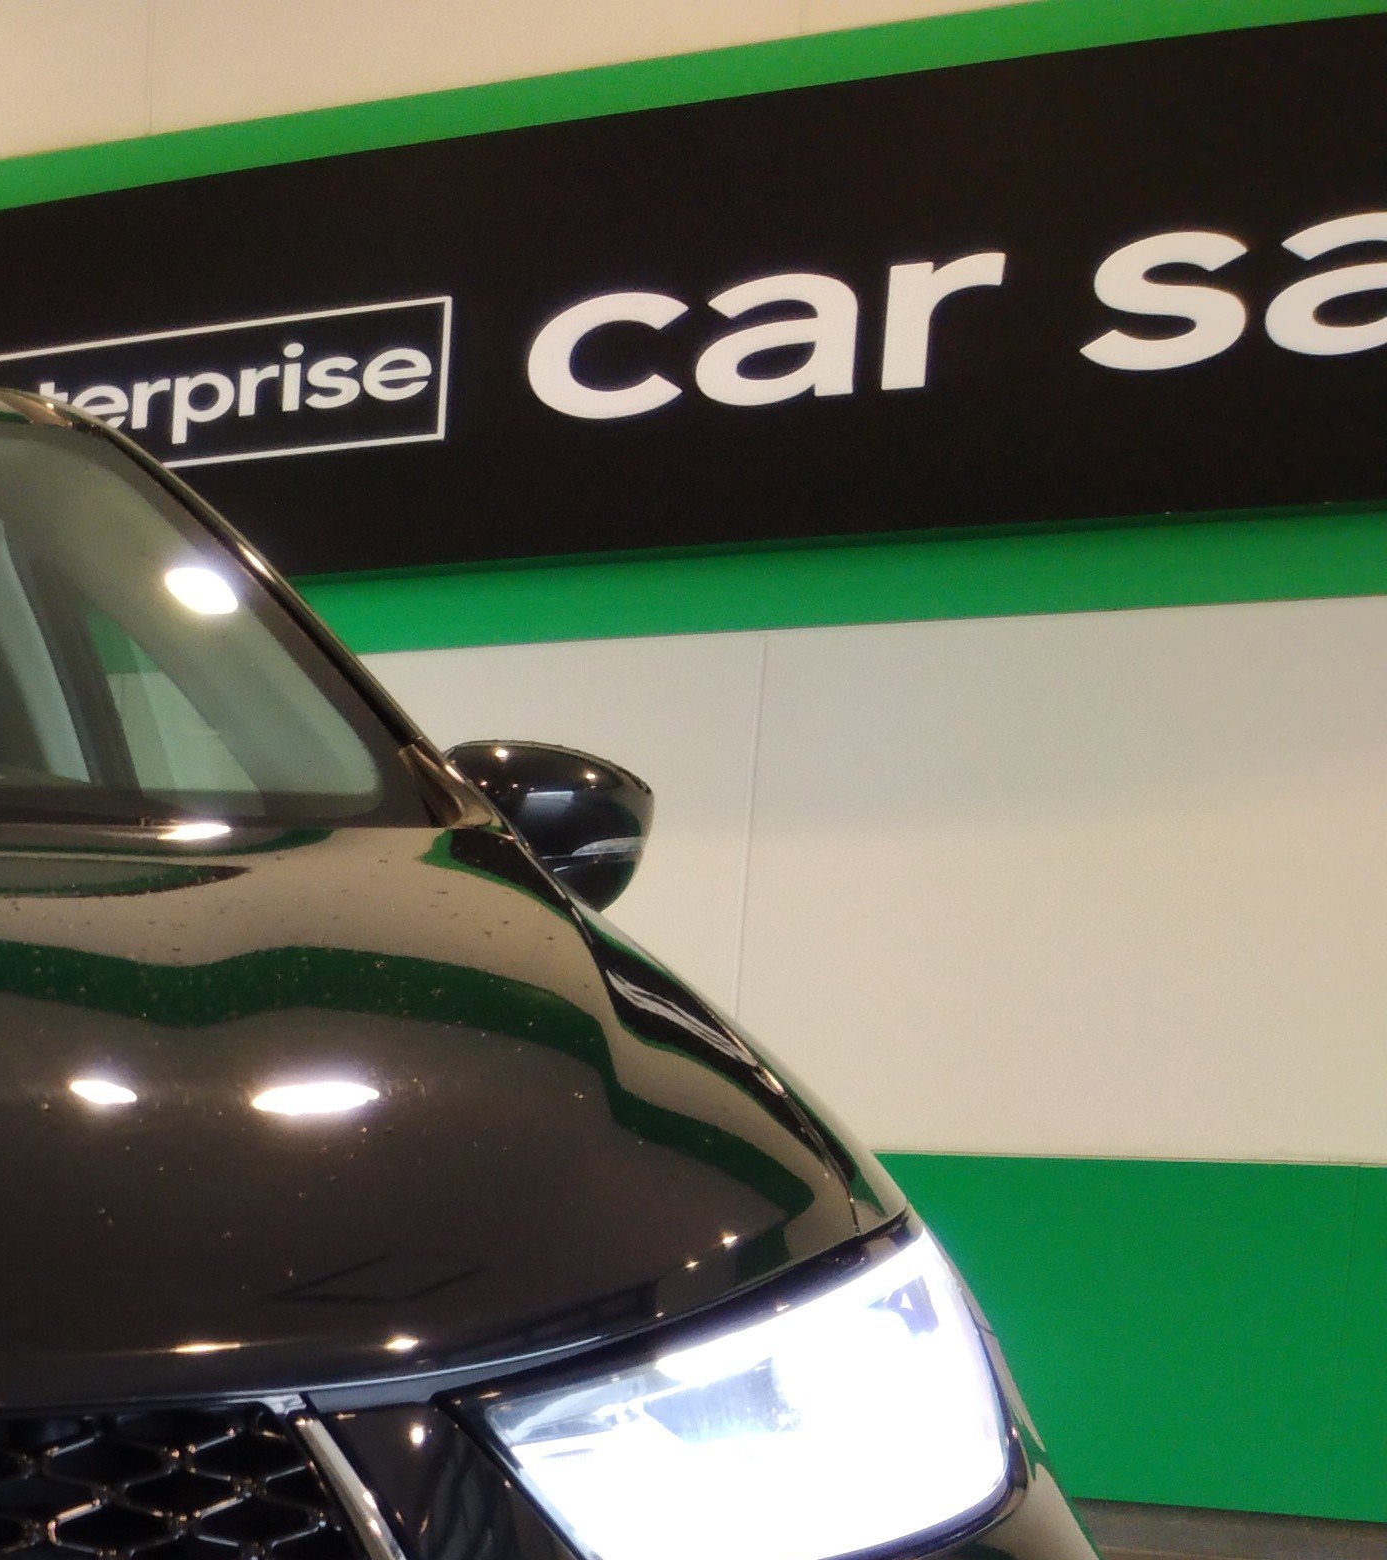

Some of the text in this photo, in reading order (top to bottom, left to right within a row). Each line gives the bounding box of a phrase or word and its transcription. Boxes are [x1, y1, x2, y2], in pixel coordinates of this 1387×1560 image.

[38, 211, 1387, 445] erprise car sa
